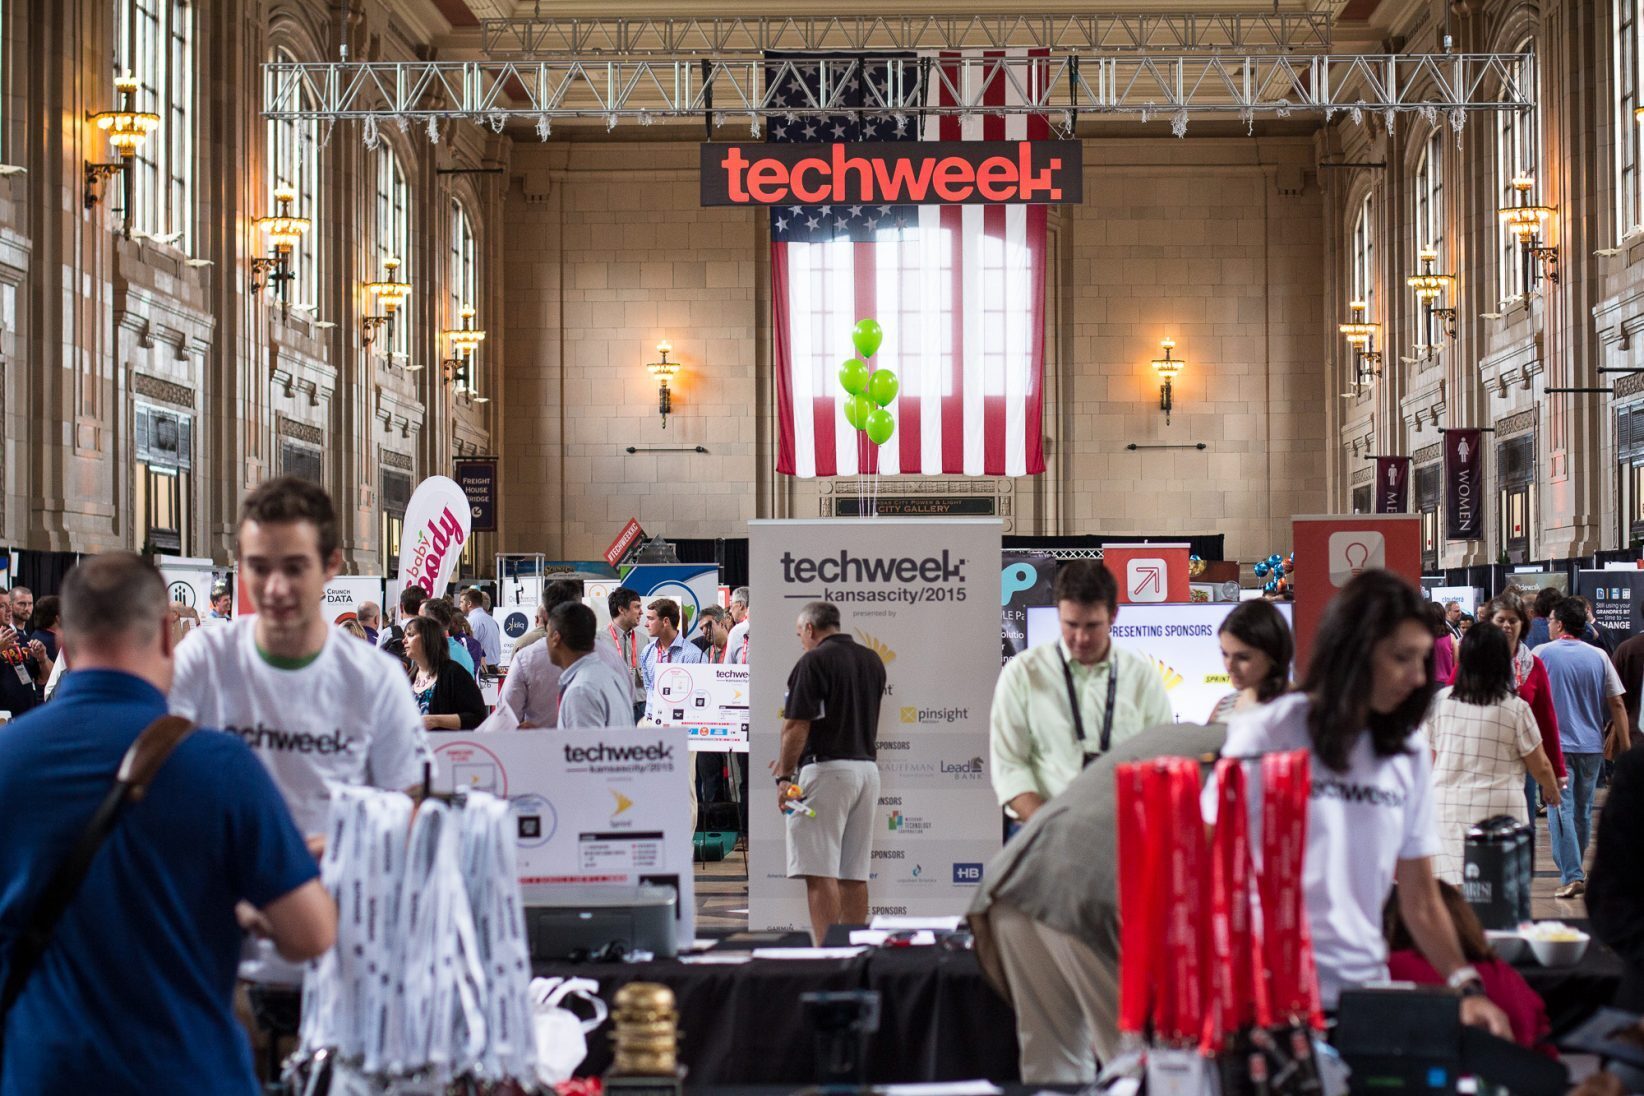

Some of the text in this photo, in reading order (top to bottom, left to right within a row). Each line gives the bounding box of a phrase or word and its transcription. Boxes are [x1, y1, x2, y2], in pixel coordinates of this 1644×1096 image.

[721, 142, 1062, 202] techweek
[1386, 491, 1398, 513] ME
[1458, 469, 1472, 531] WOMEN
[878, 505, 950, 513] CITY GALLERY
[406, 535, 431, 578] baby
[780, 549, 966, 583] techweek
[327, 595, 353, 603] DATA
[824, 587, 967, 604] kansascity/2015
[852, 609, 897, 618] presented by
[1164, 624, 1213, 637] SPONSORS
[716, 669, 749, 679] techwe
[918, 707, 969, 722] pinsight
[564, 741, 674, 763] techweek
[940, 760, 971, 773] Lead
[871, 850, 906, 860] SPONSORS
[957, 867, 981, 879] HB
[872, 906, 908, 916] SPONSORS
